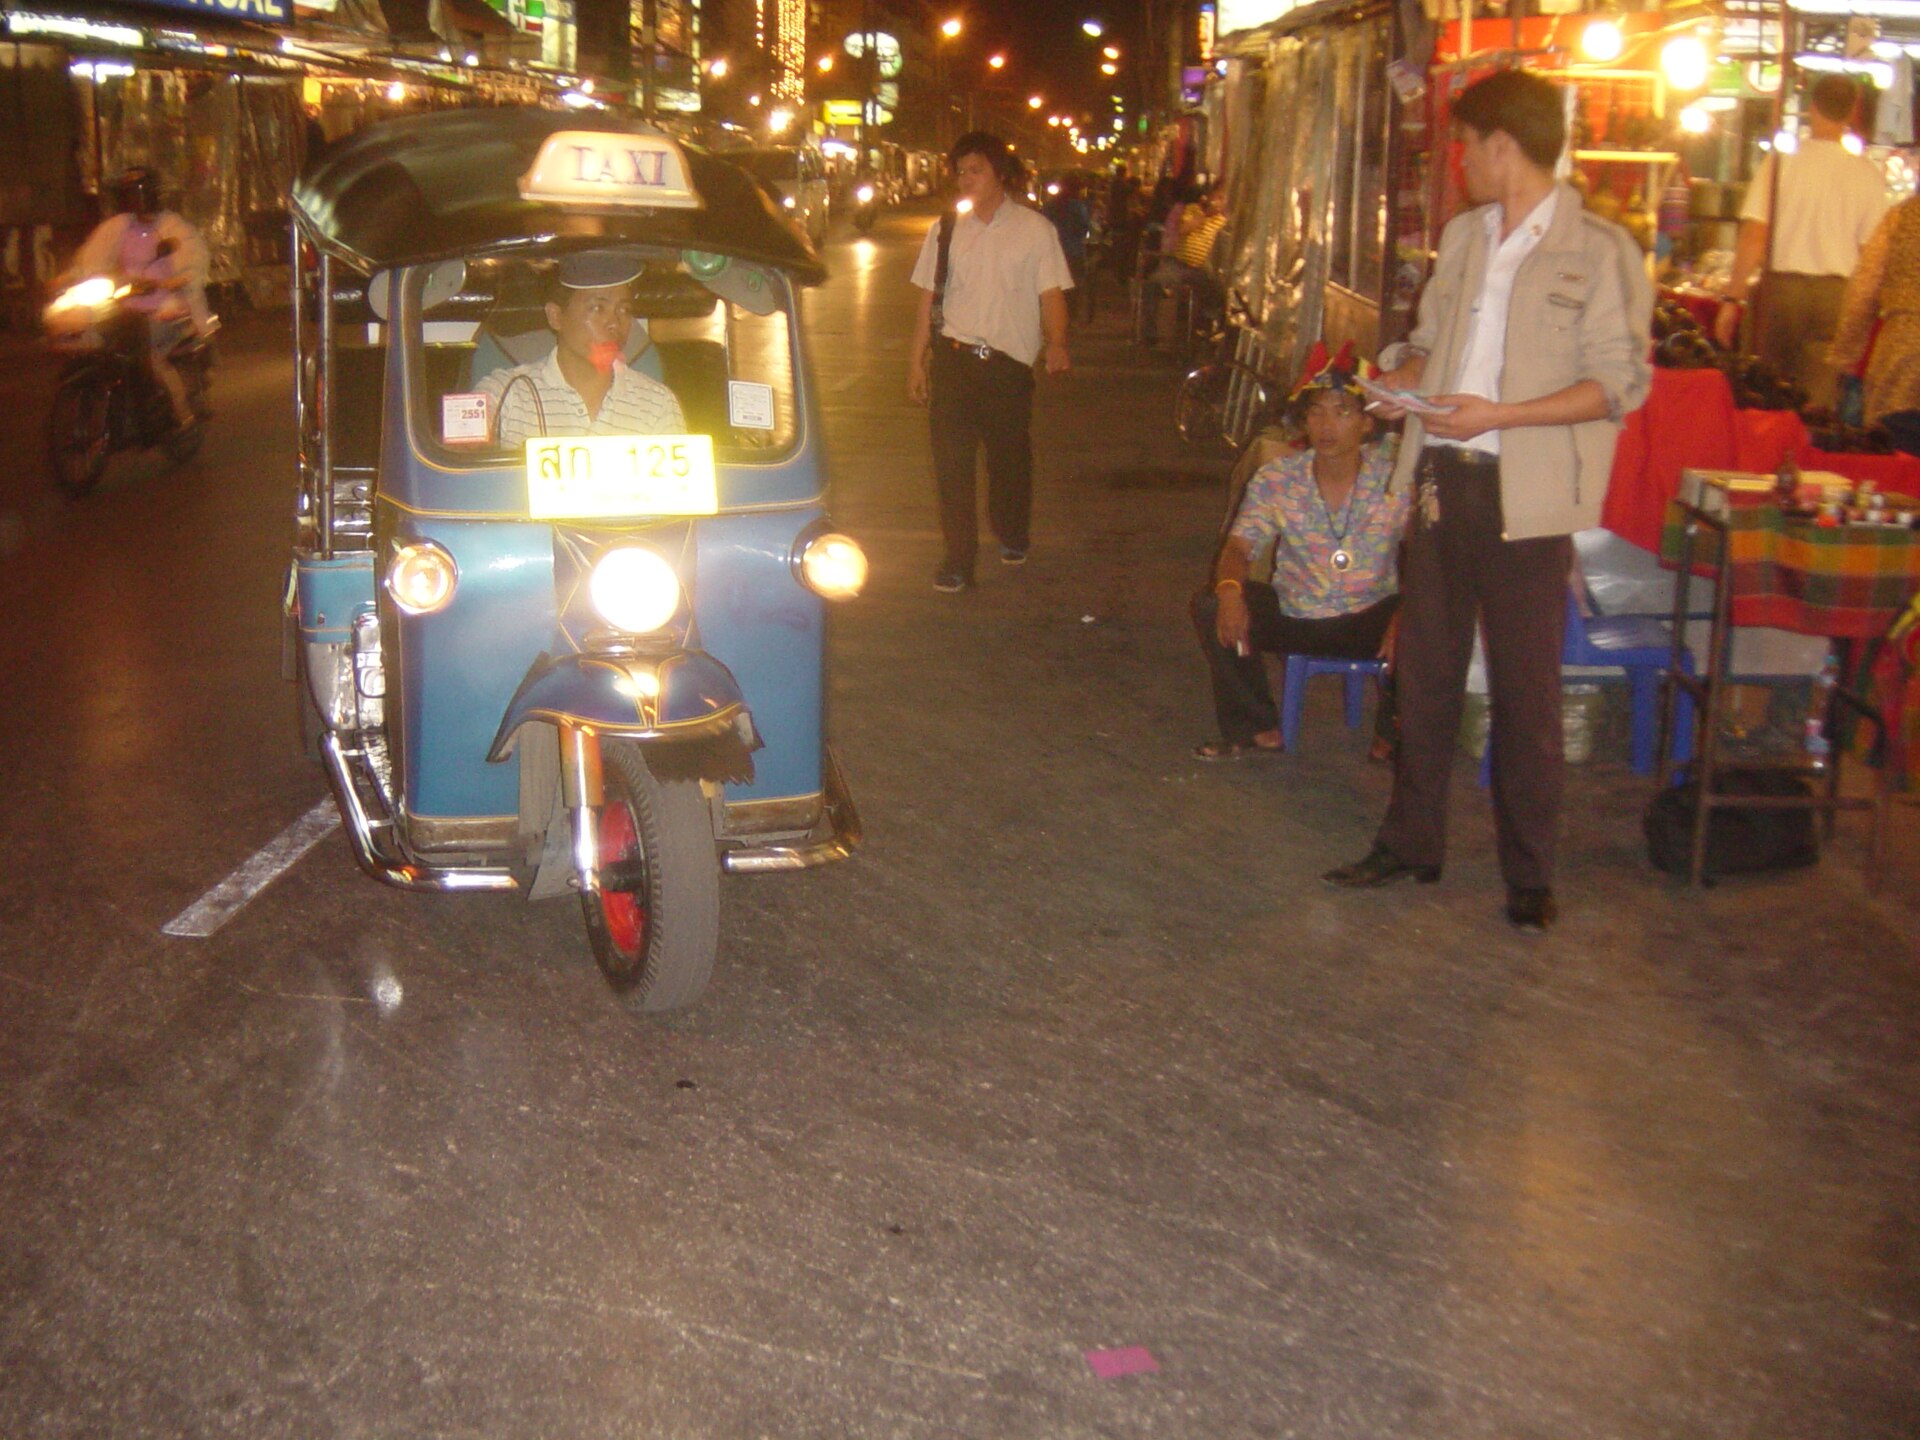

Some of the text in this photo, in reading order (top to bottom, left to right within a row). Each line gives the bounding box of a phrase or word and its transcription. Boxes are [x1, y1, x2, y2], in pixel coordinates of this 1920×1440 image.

[570, 146, 668, 186] TAXI
[461, 409, 485, 420] 2551
[627, 442, 691, 478] 125
